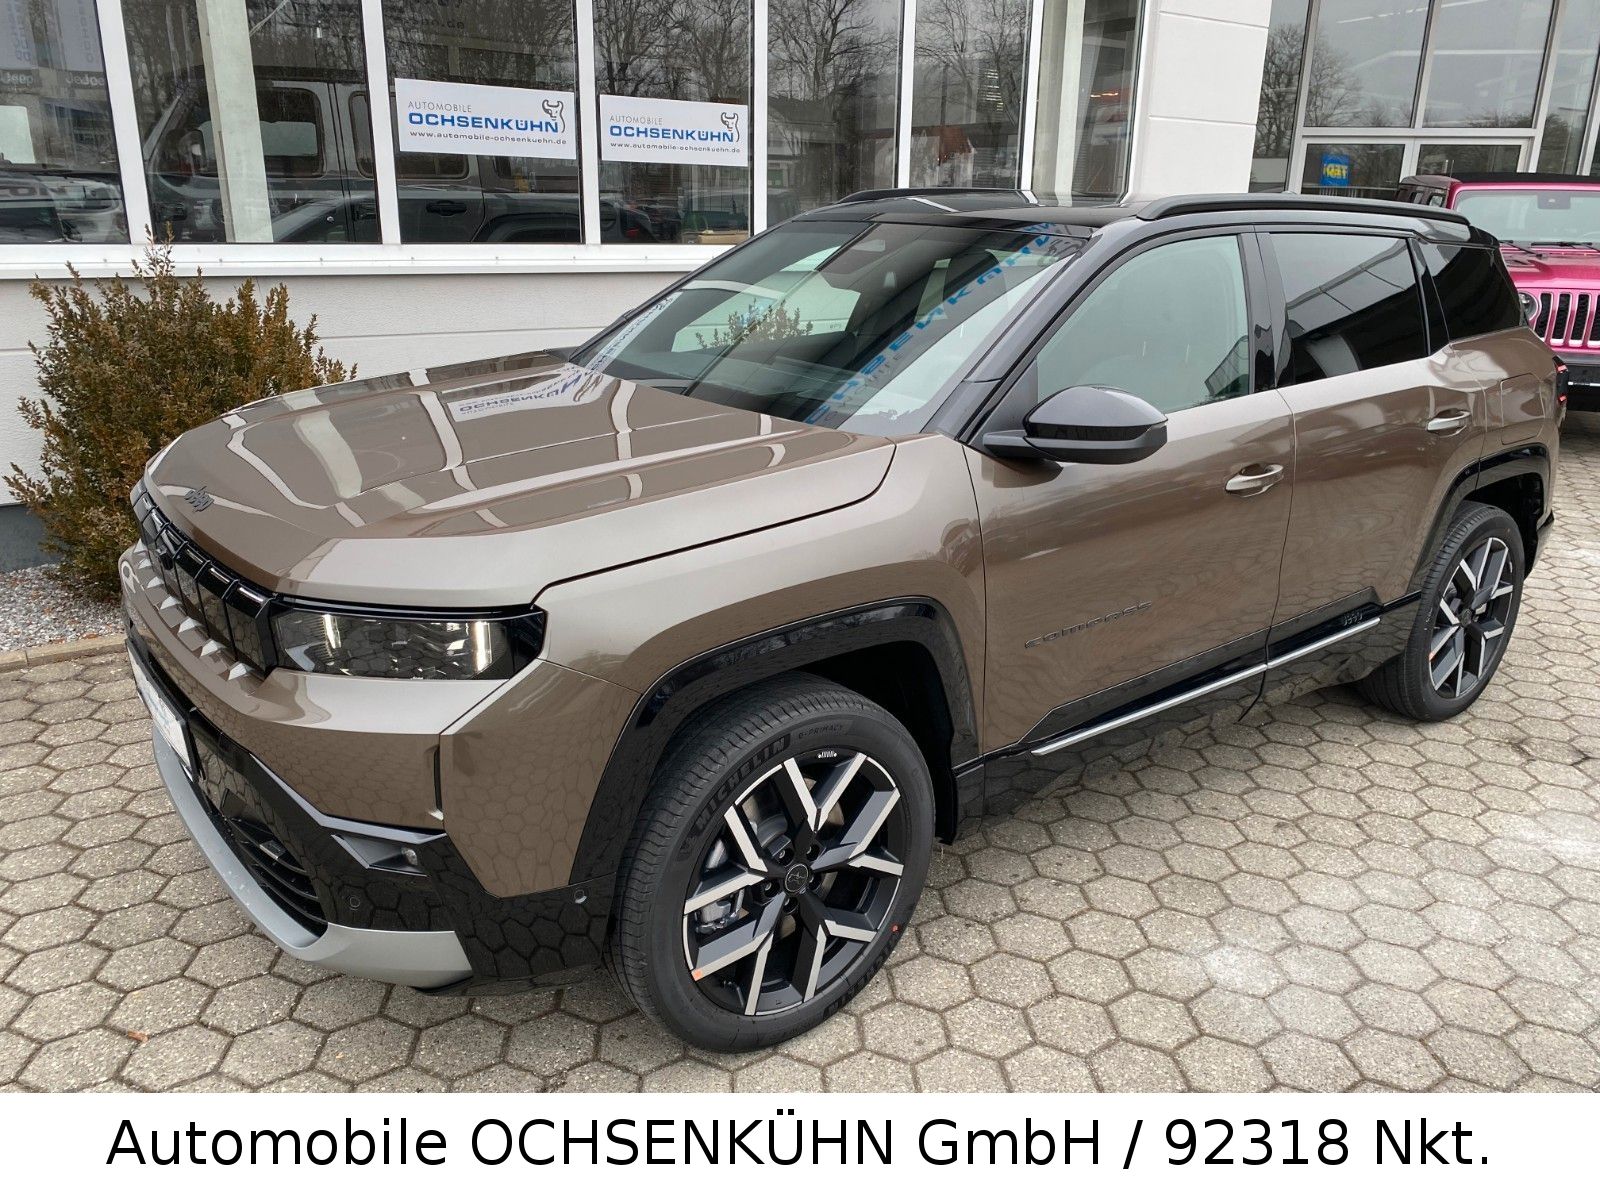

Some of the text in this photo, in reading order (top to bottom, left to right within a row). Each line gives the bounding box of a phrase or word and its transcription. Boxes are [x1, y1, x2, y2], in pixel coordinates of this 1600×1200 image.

[407, 100, 472, 113] AUTOMOBILE
[408, 112, 558, 134] OCHSENKÜHN
[609, 115, 663, 126] AUTOMOBILE
[409, 131, 567, 146] www.automobile-ochsenkuehn.de
[609, 125, 734, 143] OCHSENKÜHN
[610, 142, 740, 154] www.automobile-ochsenkuehn.de
[694, 736, 787, 832] MICHELIN
